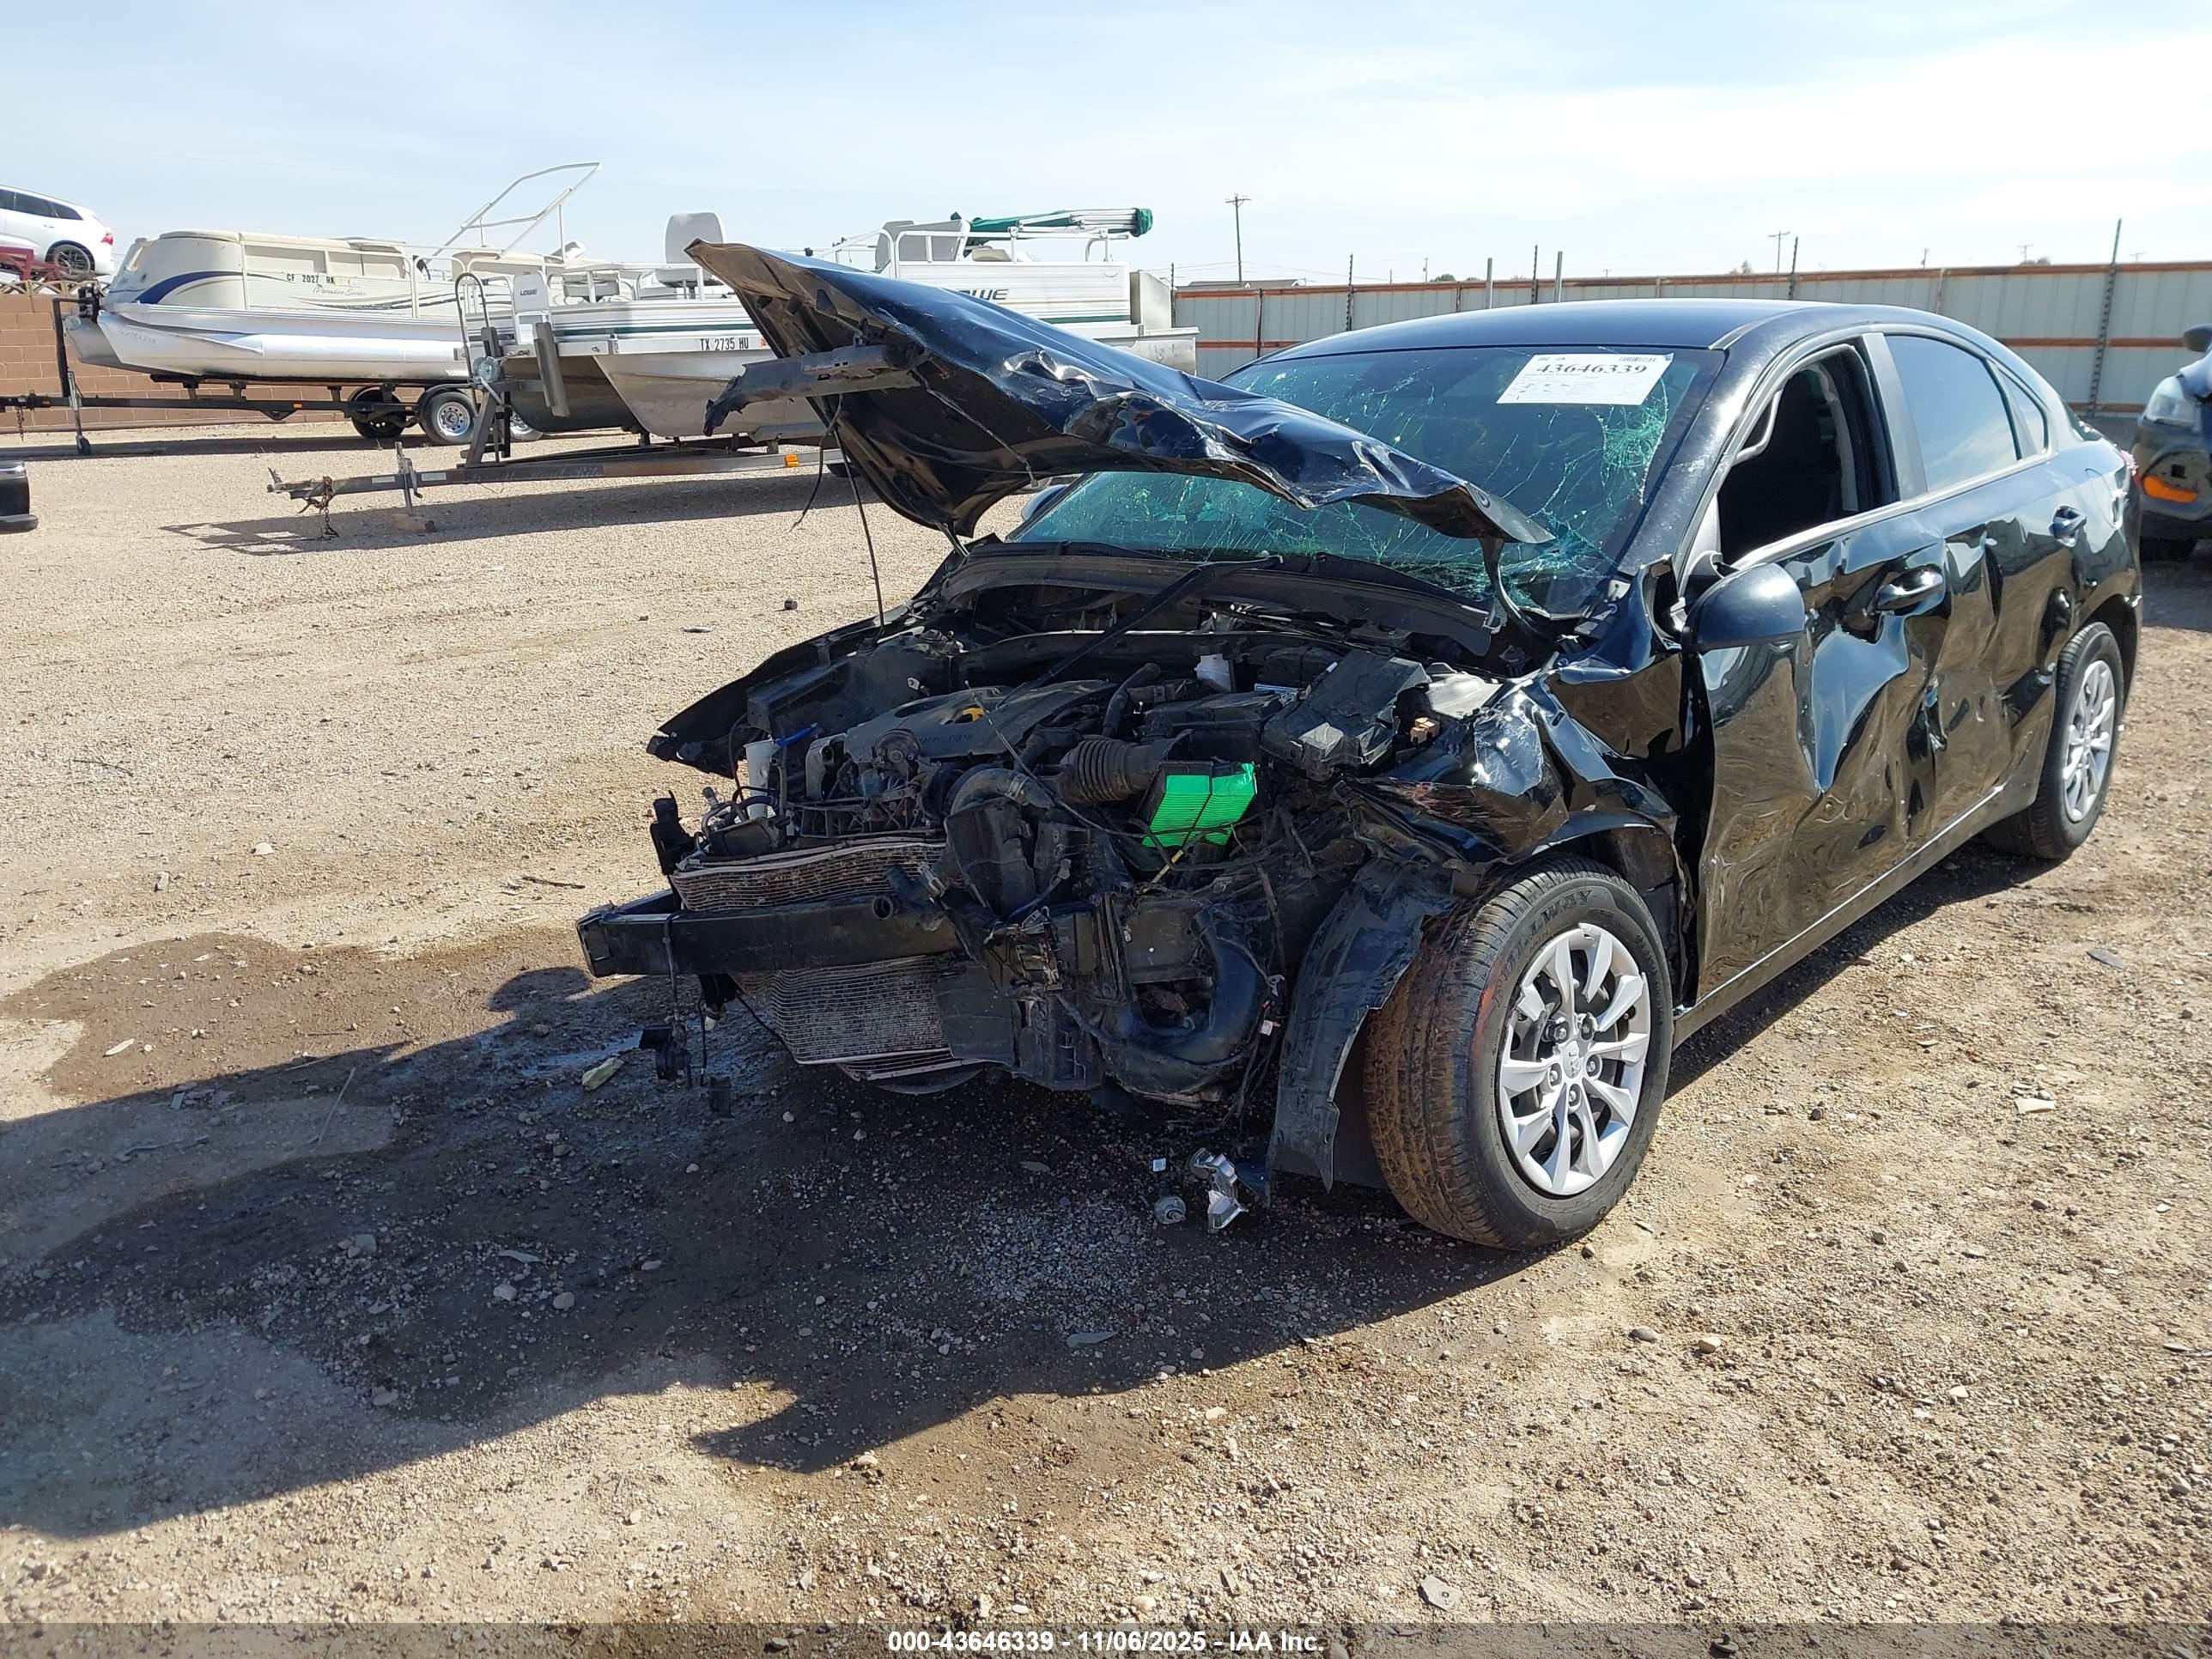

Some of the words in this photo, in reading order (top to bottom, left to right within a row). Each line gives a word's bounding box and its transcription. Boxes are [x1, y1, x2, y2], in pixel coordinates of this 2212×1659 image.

[286, 273, 295, 282] CF
[302, 274, 319, 283] 2027
[700, 338, 709, 350] TX
[714, 337, 735, 350] 2735
[739, 337, 749, 349] HU
[1536, 363, 1648, 374] 43646339
